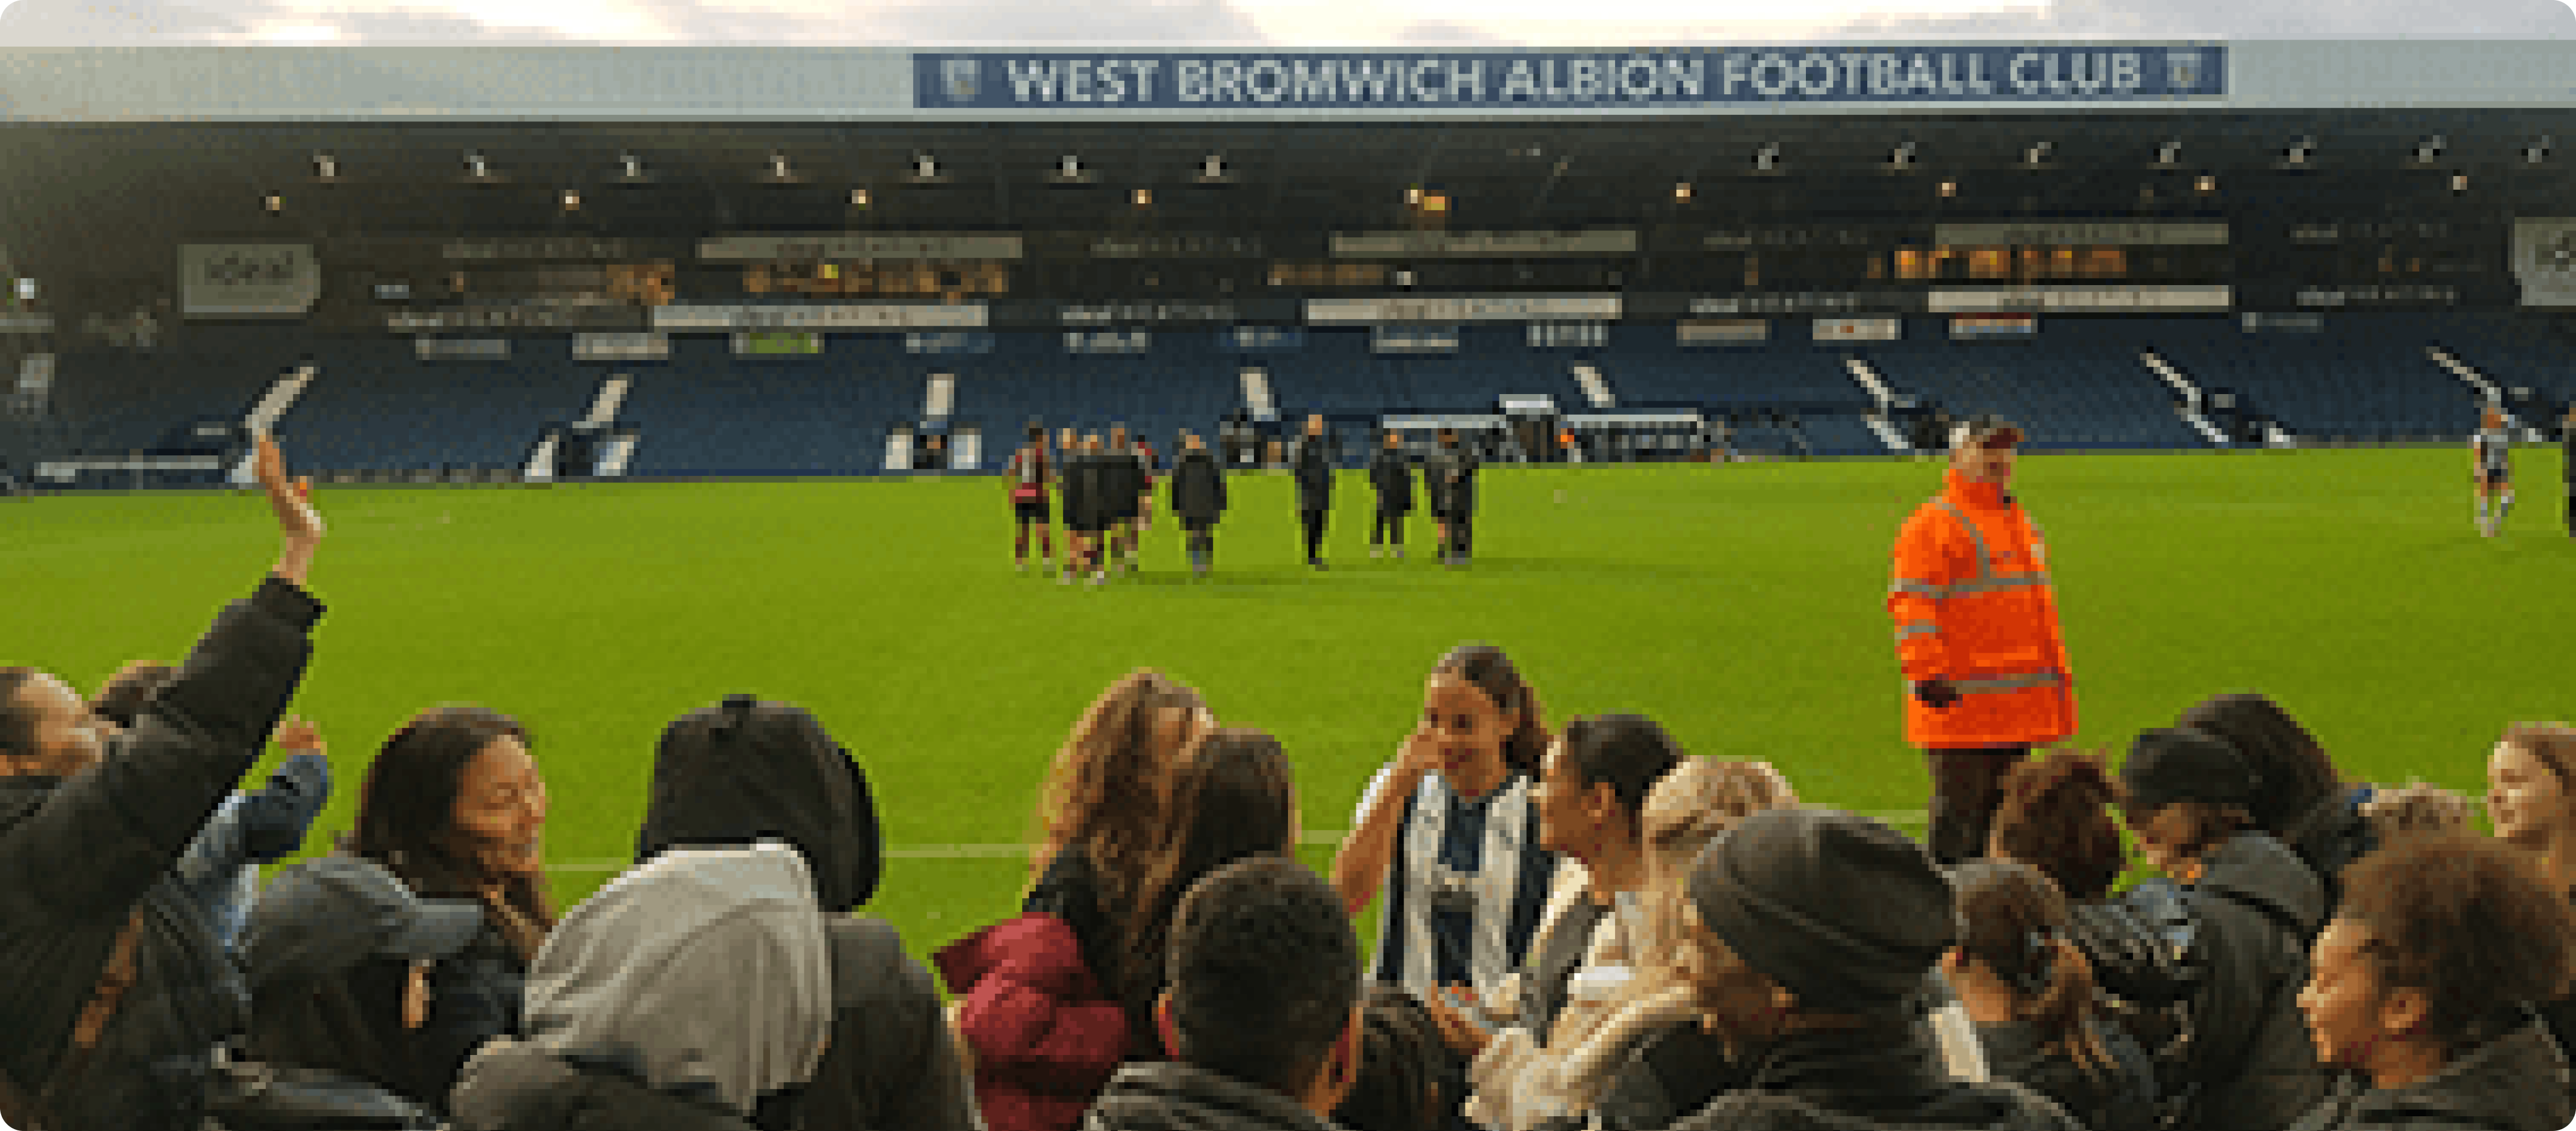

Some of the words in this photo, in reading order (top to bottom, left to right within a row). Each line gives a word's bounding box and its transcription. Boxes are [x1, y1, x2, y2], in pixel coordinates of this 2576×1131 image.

[1008, 59, 1159, 101] WEST
[1178, 59, 1485, 101] BROMWICH
[1503, 58, 1705, 101] ALBION
[1723, 53, 1990, 95] FOOTBALL
[2010, 53, 2141, 95] CLUB
